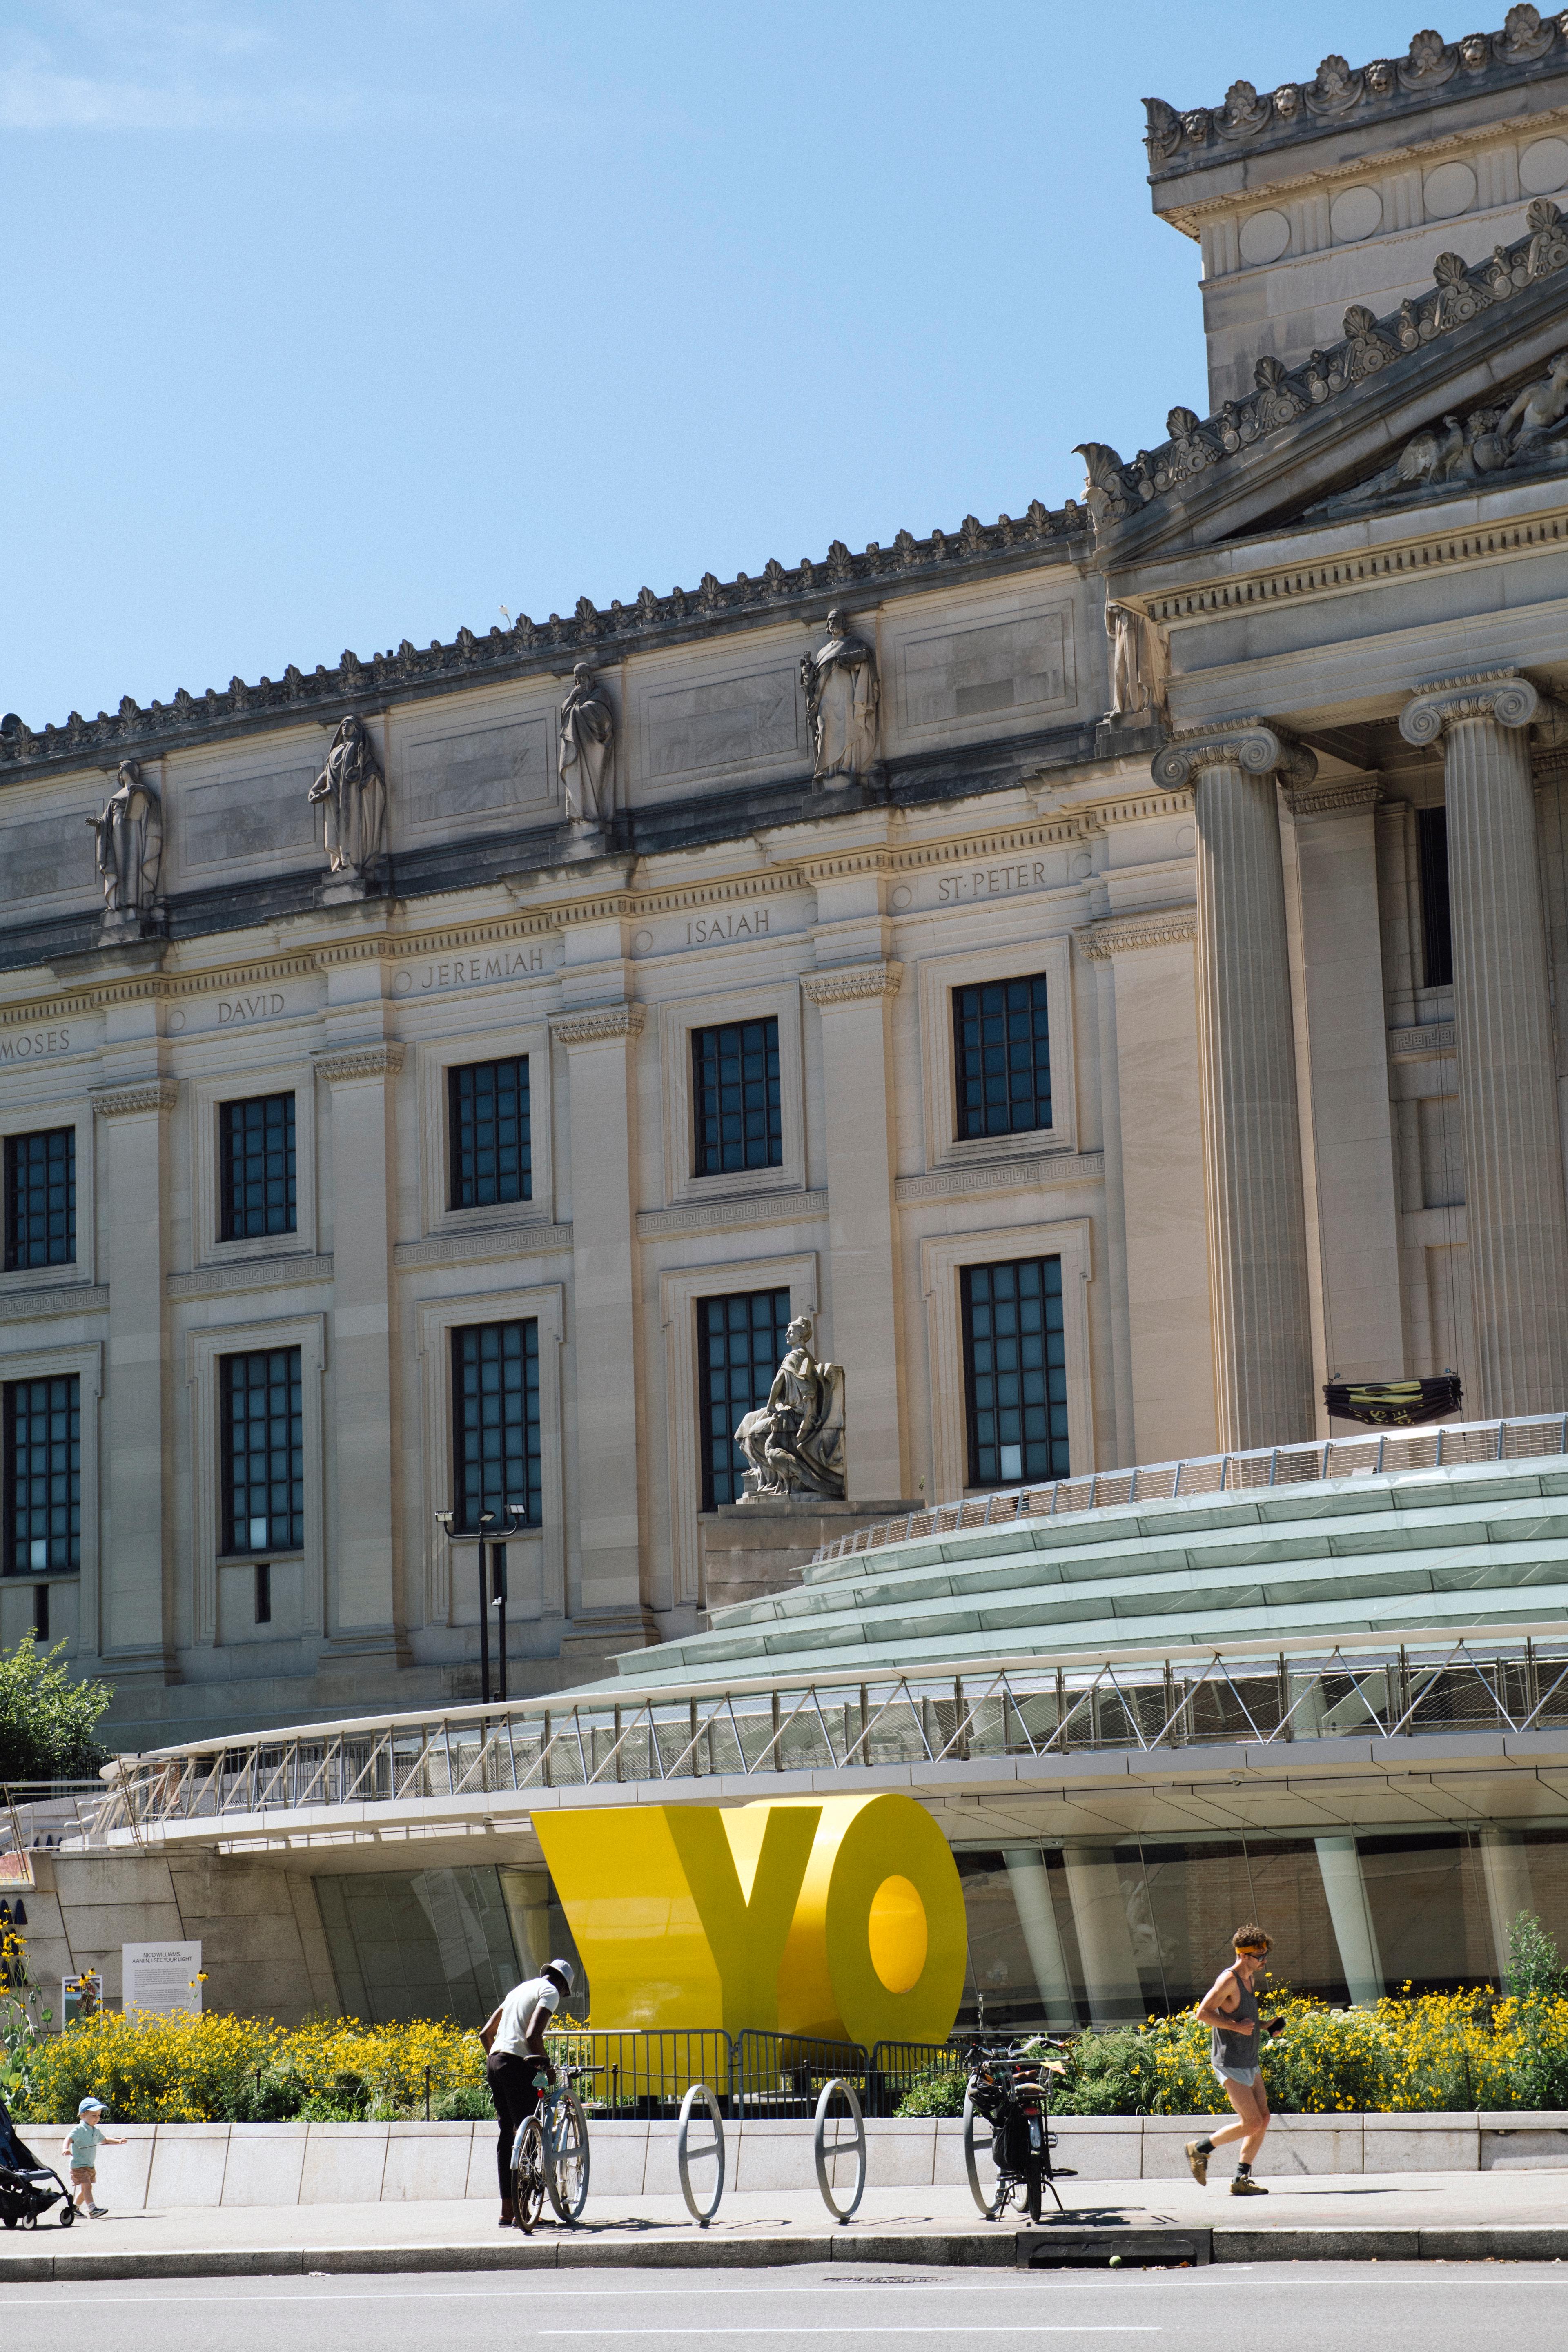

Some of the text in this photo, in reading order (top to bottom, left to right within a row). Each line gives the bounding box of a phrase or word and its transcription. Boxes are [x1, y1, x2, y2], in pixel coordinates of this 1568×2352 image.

[971, 862, 1047, 896] PETER
[686, 909, 769, 944] ISAIAH
[421, 948, 543, 988] JEREMIAH
[218, 994, 284, 1023] DAVID
[0, 1030, 69, 1060] MOSES
[663, 1793, 967, 2095] YO
